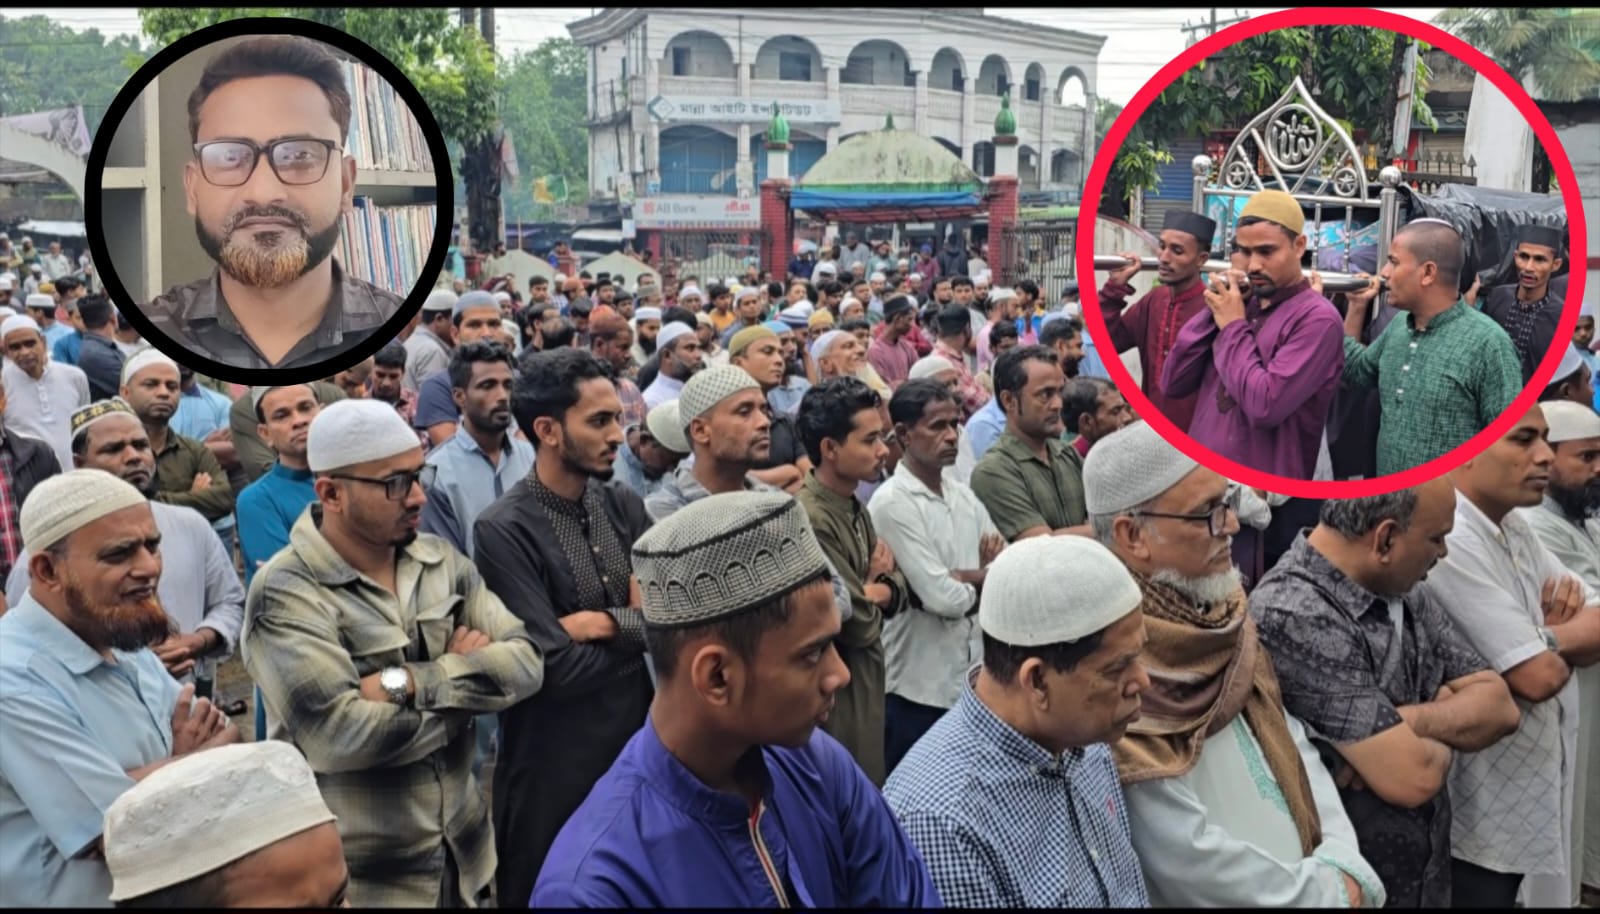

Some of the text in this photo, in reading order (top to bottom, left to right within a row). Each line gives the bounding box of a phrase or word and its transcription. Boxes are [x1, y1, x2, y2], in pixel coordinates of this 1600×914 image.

[710, 101, 746, 114] আইটি
[656, 202, 697, 214] AB Bank
